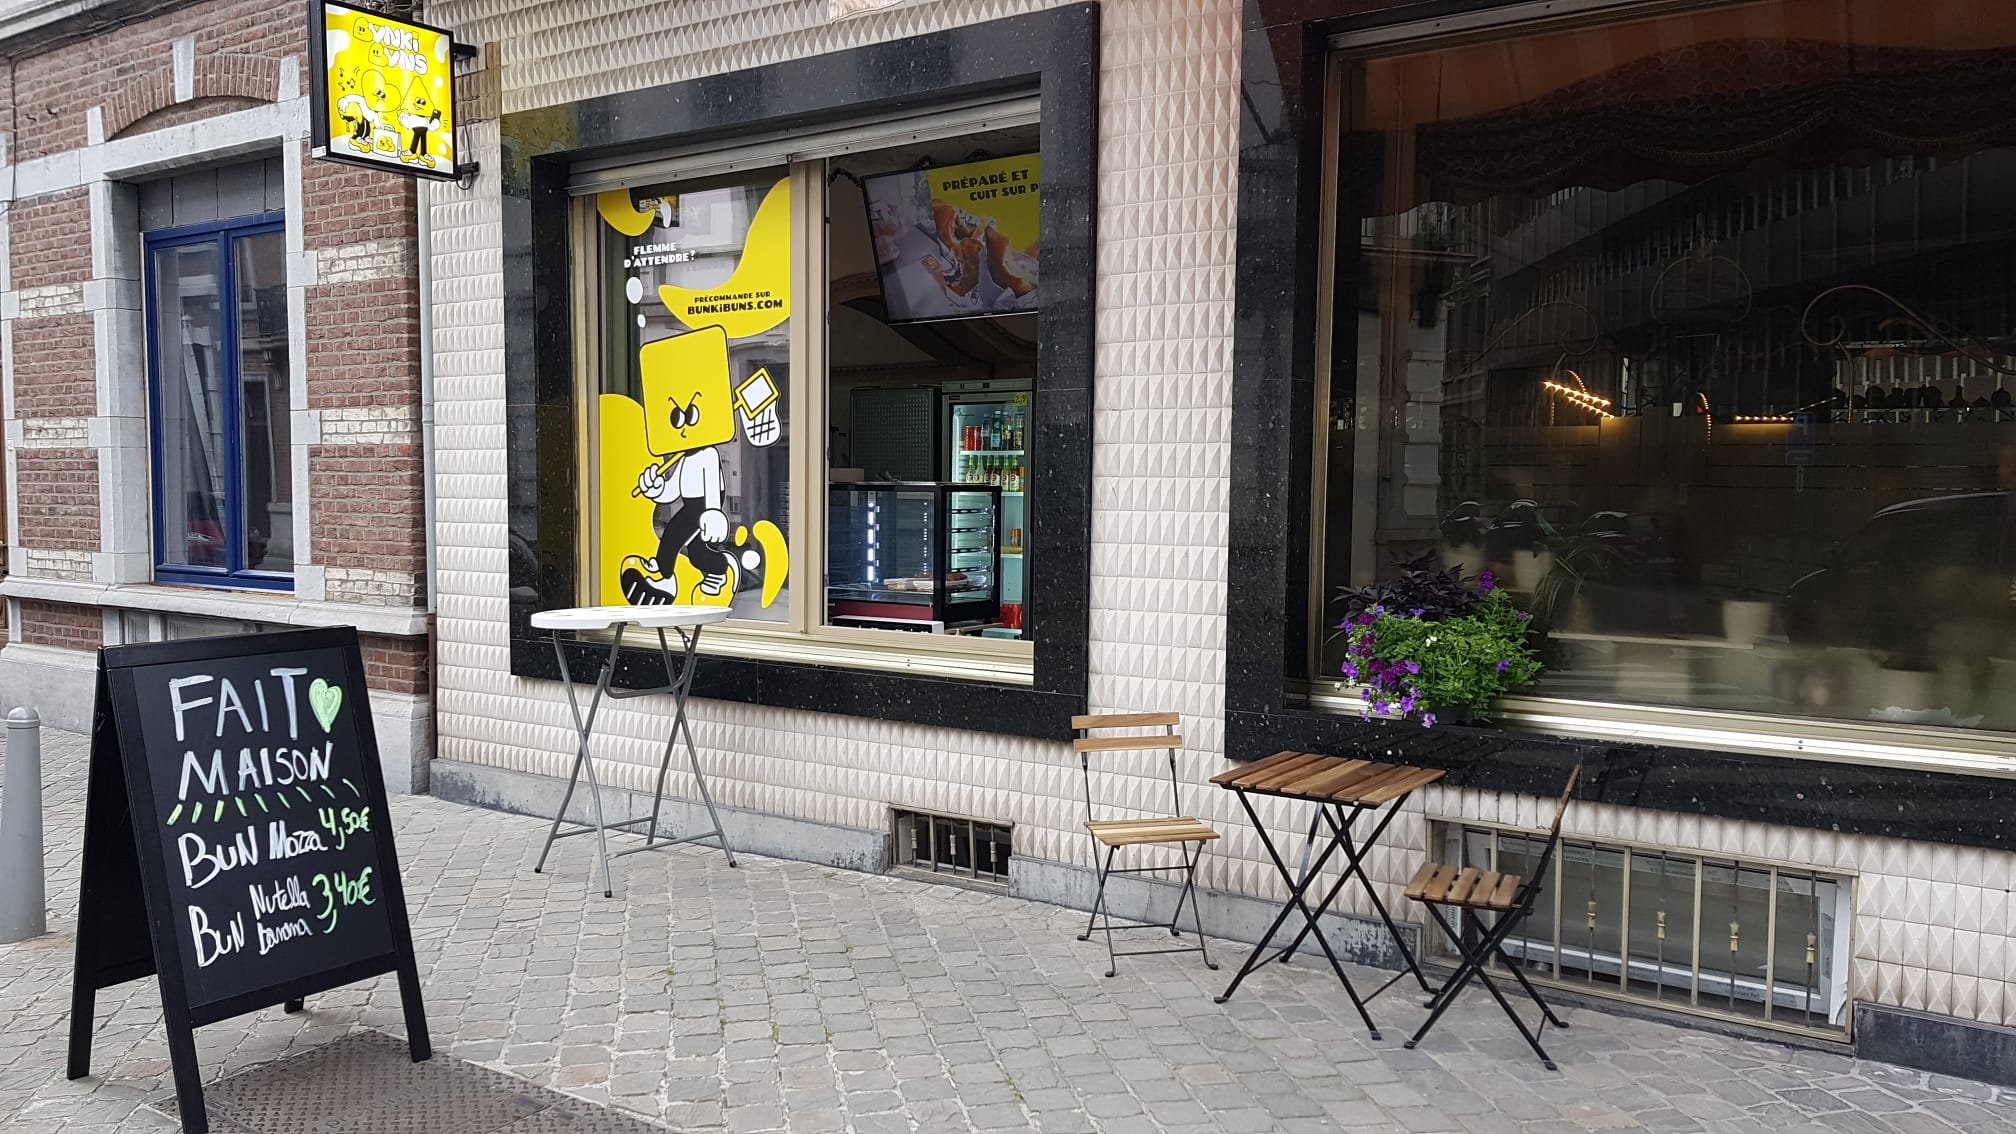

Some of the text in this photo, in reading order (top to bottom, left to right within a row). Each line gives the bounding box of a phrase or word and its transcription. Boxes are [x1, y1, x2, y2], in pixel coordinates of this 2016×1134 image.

[942, 169, 1029, 191] PRÉPARÉ ET
[969, 183, 1040, 201] CUIT SUR P
[624, 250, 696, 268] D'ATTENDRE?
[633, 242, 677, 256] FLEMME
[694, 292, 753, 303] PRÉCOMMANDE
[169, 667, 308, 742] FAIT
[178, 740, 334, 801] MAISON
[318, 806, 371, 850] 4,50€
[249, 875, 311, 920] Nutella
[312, 866, 376, 934] 3,40€
